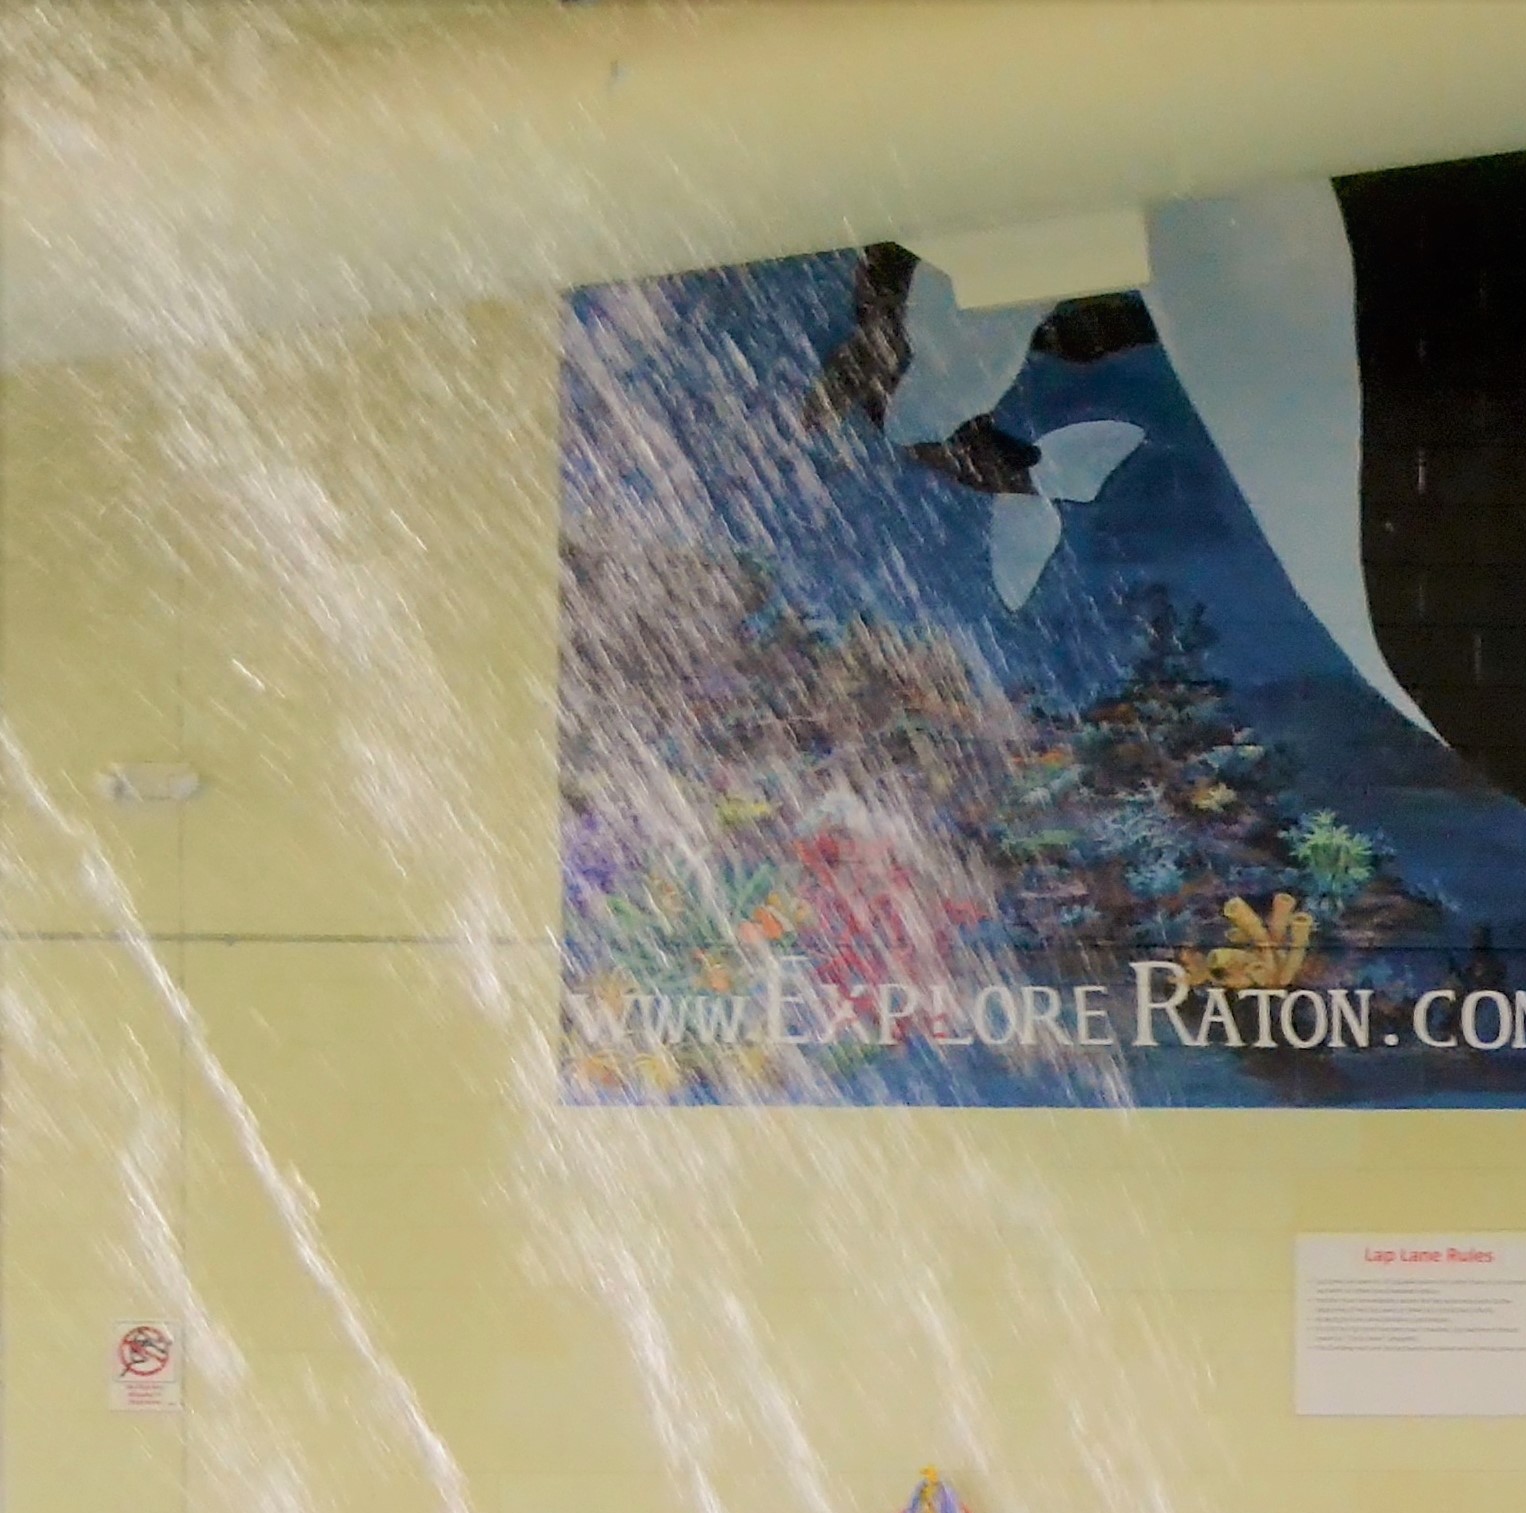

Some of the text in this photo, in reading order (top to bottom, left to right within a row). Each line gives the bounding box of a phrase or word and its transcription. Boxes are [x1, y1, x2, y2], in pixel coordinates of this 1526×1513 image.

[1364, 1247, 1495, 1264] Lap Lane Rules
